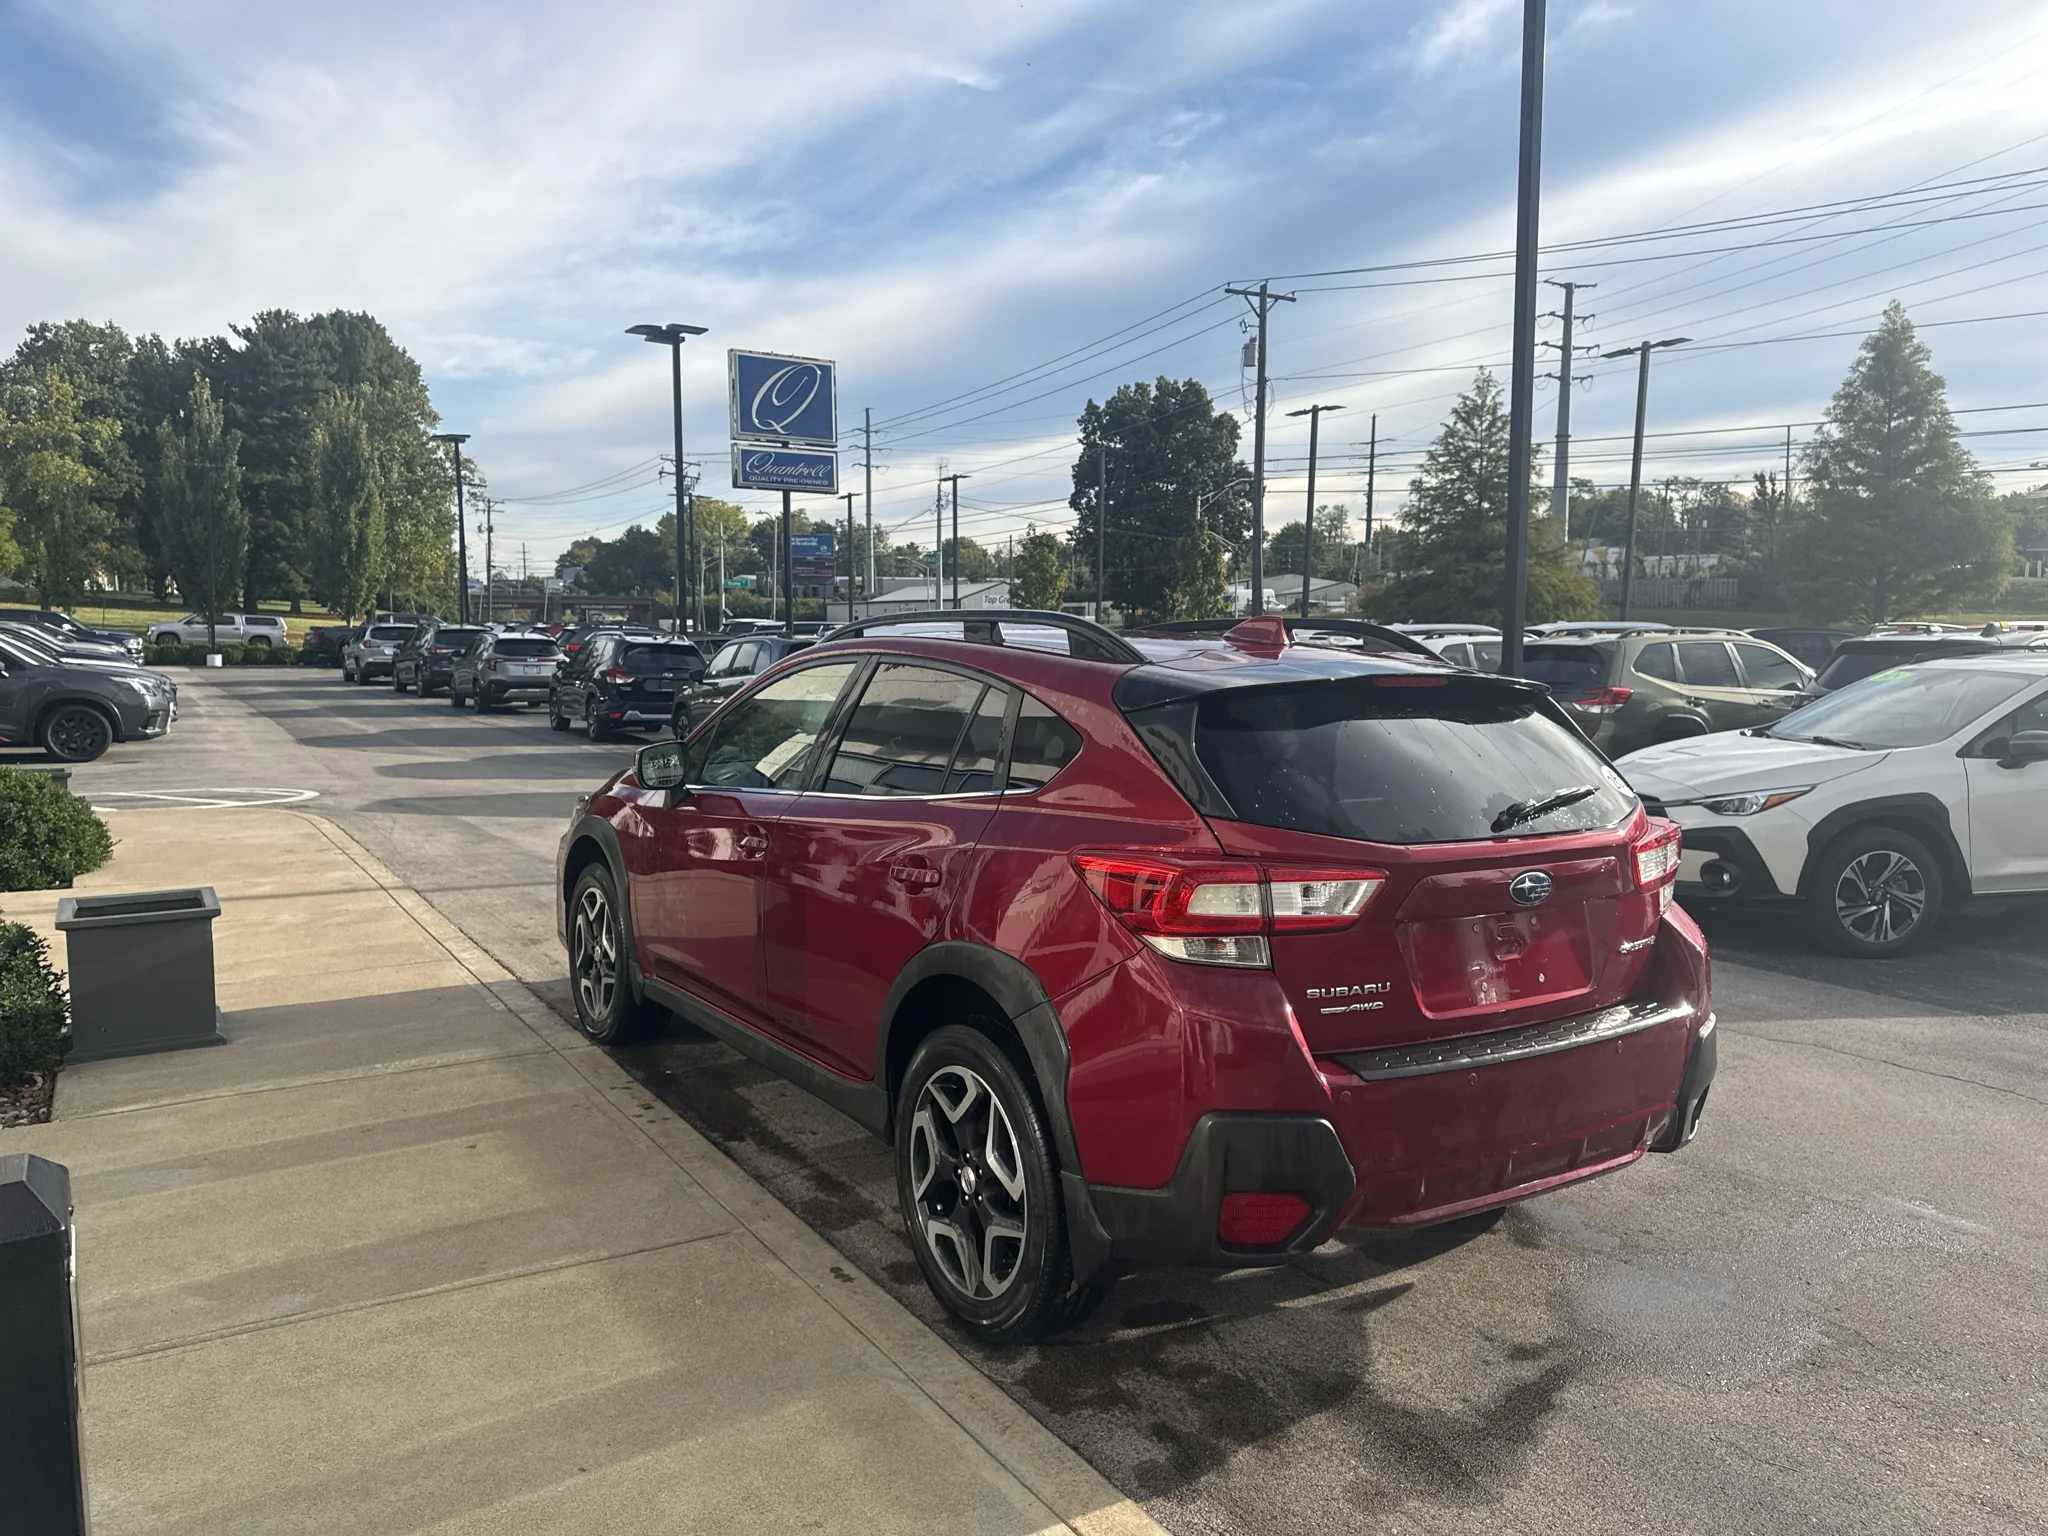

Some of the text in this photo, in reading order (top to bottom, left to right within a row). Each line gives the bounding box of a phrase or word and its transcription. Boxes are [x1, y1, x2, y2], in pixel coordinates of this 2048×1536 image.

[751, 363, 821, 435] Q
[745, 451, 831, 477] Quantrell
[749, 475, 828, 486] QUALITY PRE-OWNED
[984, 595, 998, 605] Top
[1306, 981, 1391, 999] SUBARU
[1345, 1001, 1385, 1012] AWD
